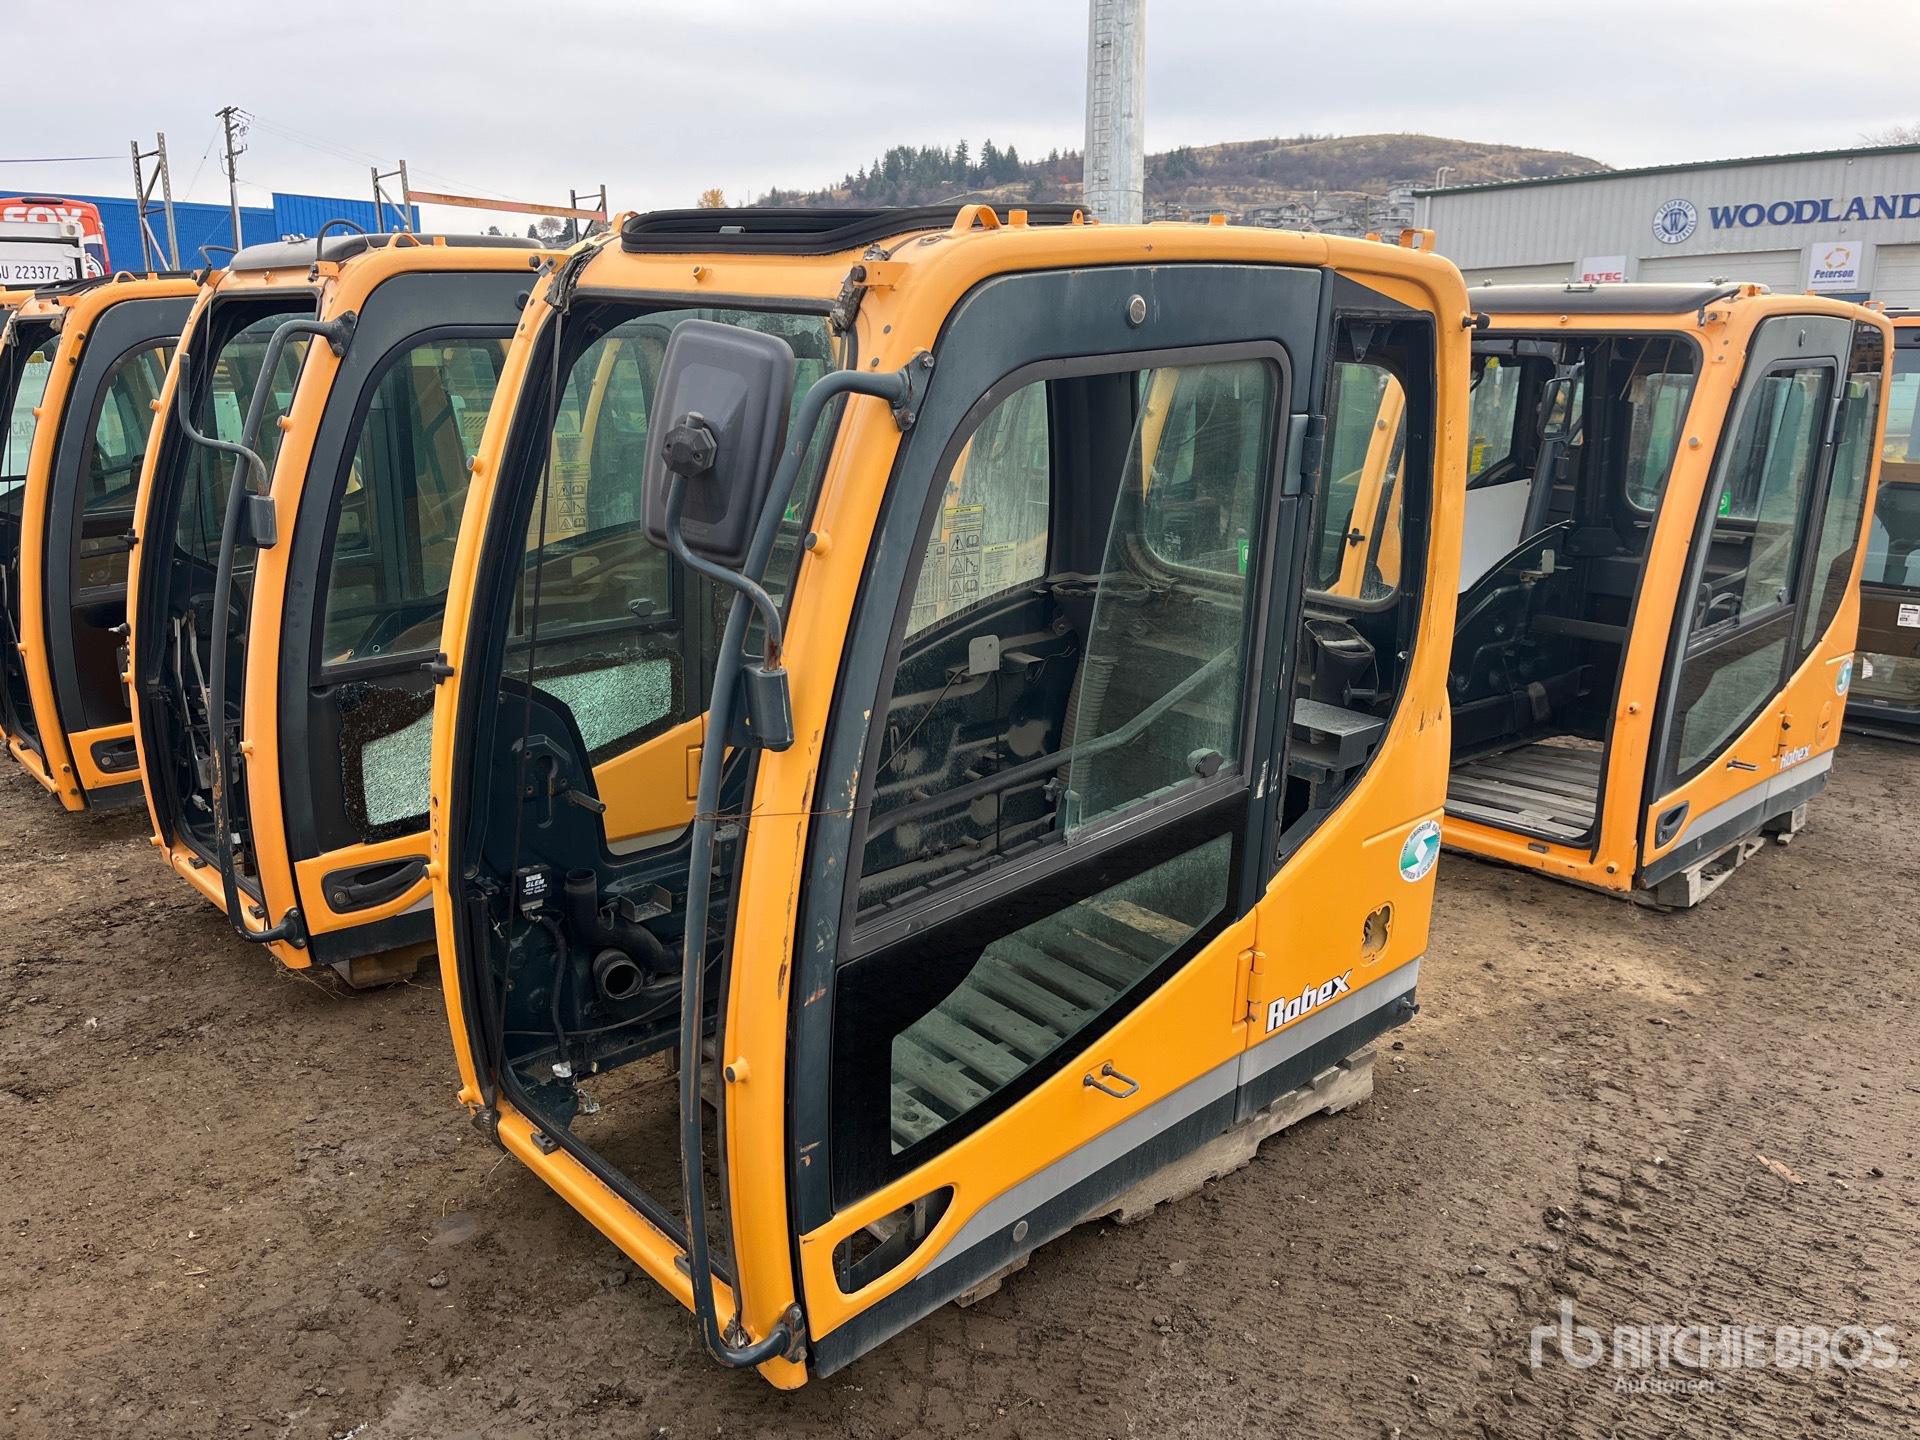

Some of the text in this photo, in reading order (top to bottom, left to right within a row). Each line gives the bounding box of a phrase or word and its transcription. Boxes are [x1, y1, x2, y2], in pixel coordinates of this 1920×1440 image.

[1708, 193, 1920, 229] WOODLAND
[0, 265, 74, 280] U 223372 3
[1583, 271, 1622, 282] ELTEC
[1813, 269, 1854, 279] Peterson
[1265, 968, 1353, 1033] Robex
